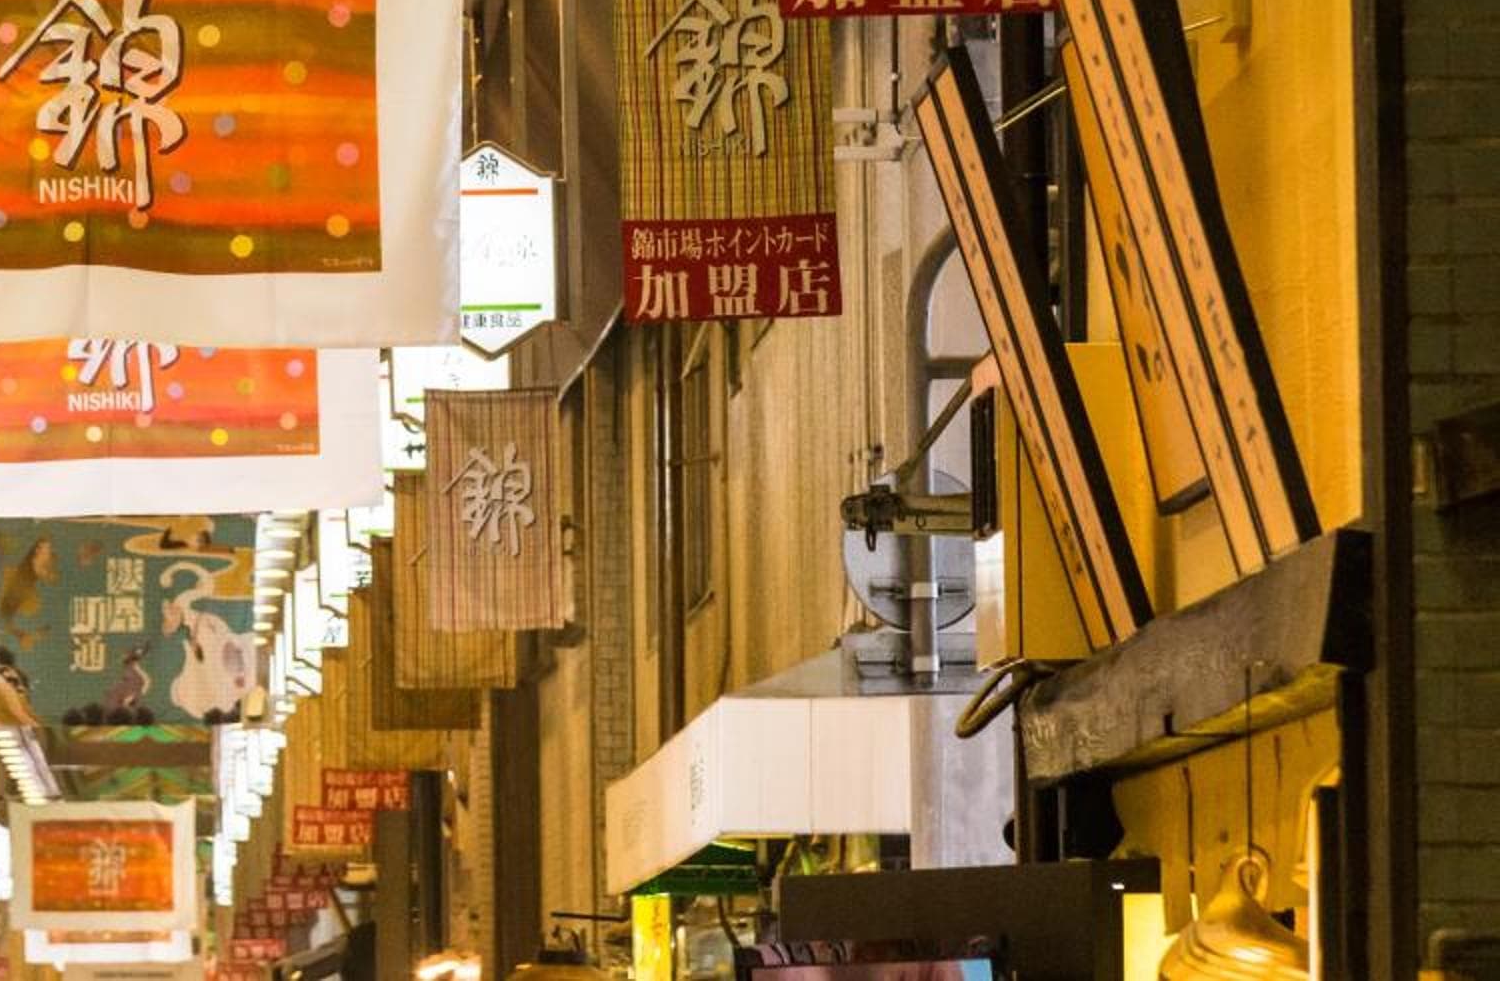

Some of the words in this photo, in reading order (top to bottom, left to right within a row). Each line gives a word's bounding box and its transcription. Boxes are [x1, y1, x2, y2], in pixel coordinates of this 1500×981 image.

[39, 176, 134, 204] NISHIKI
[631, 222, 829, 263] 錦市場ポイントカード
[635, 259, 832, 319] 加盟店
[68, 392, 141, 412] NISHIKI
[441, 441, 536, 557] 錦
